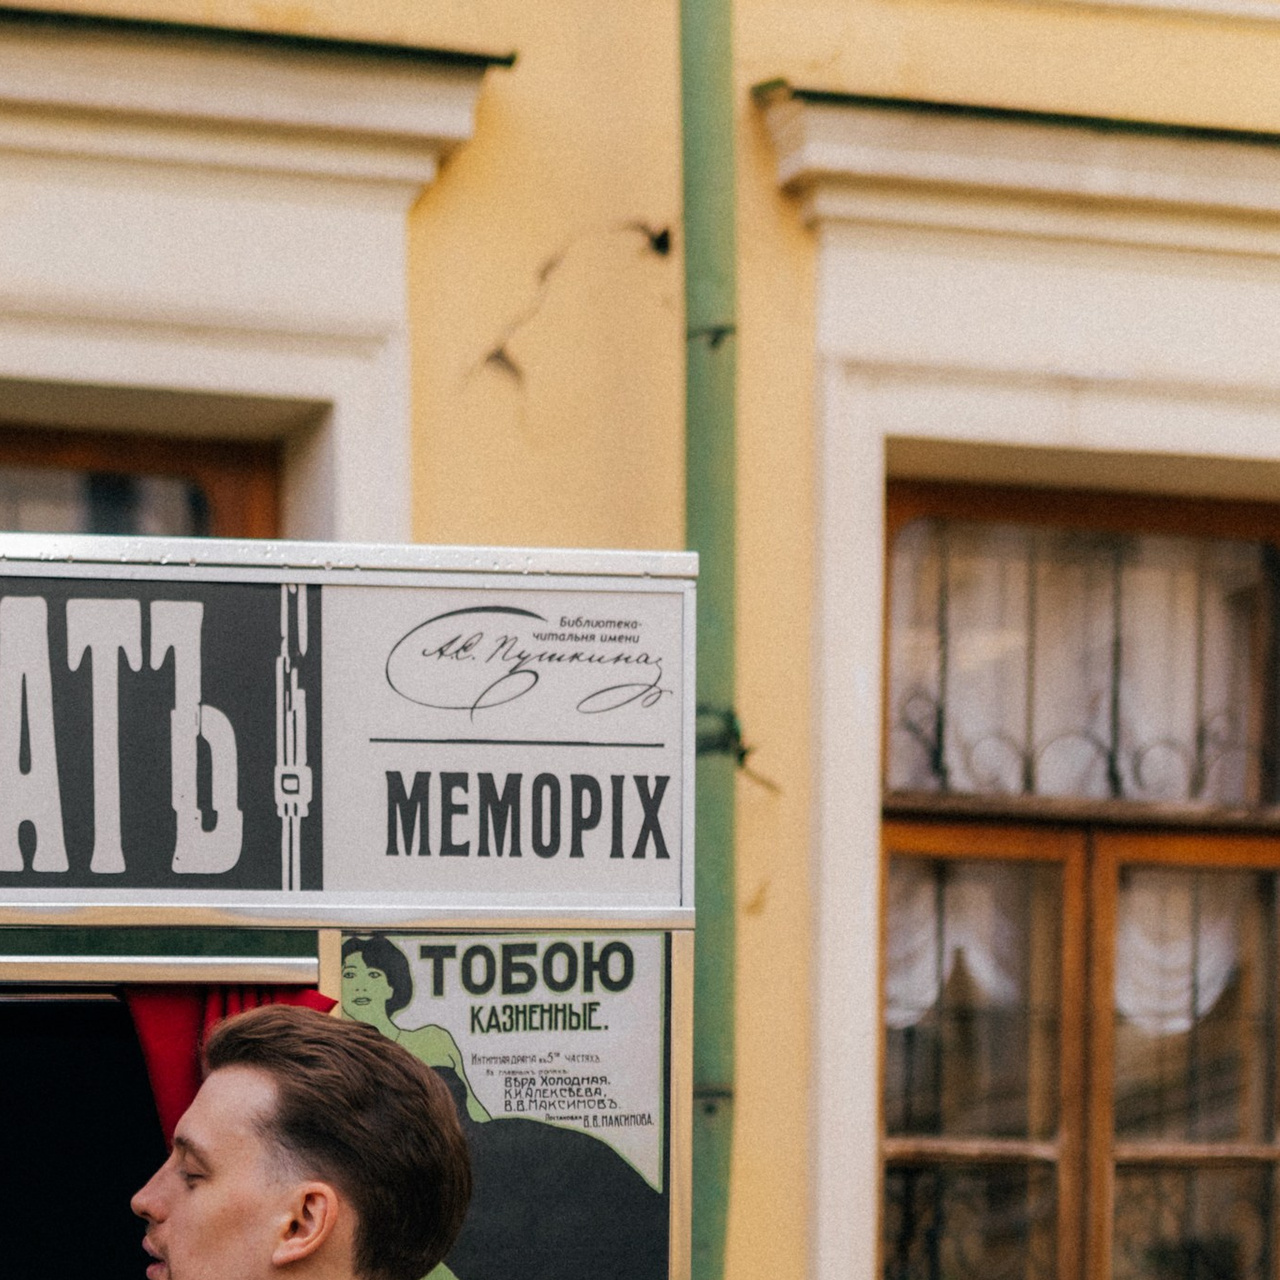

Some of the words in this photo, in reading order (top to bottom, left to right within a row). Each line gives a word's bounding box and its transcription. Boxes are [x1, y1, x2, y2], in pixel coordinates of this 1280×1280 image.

[532, 631, 596, 644] читальня
[600, 631, 640, 644] имени
[420, 940, 635, 998] ТОБОЮ
